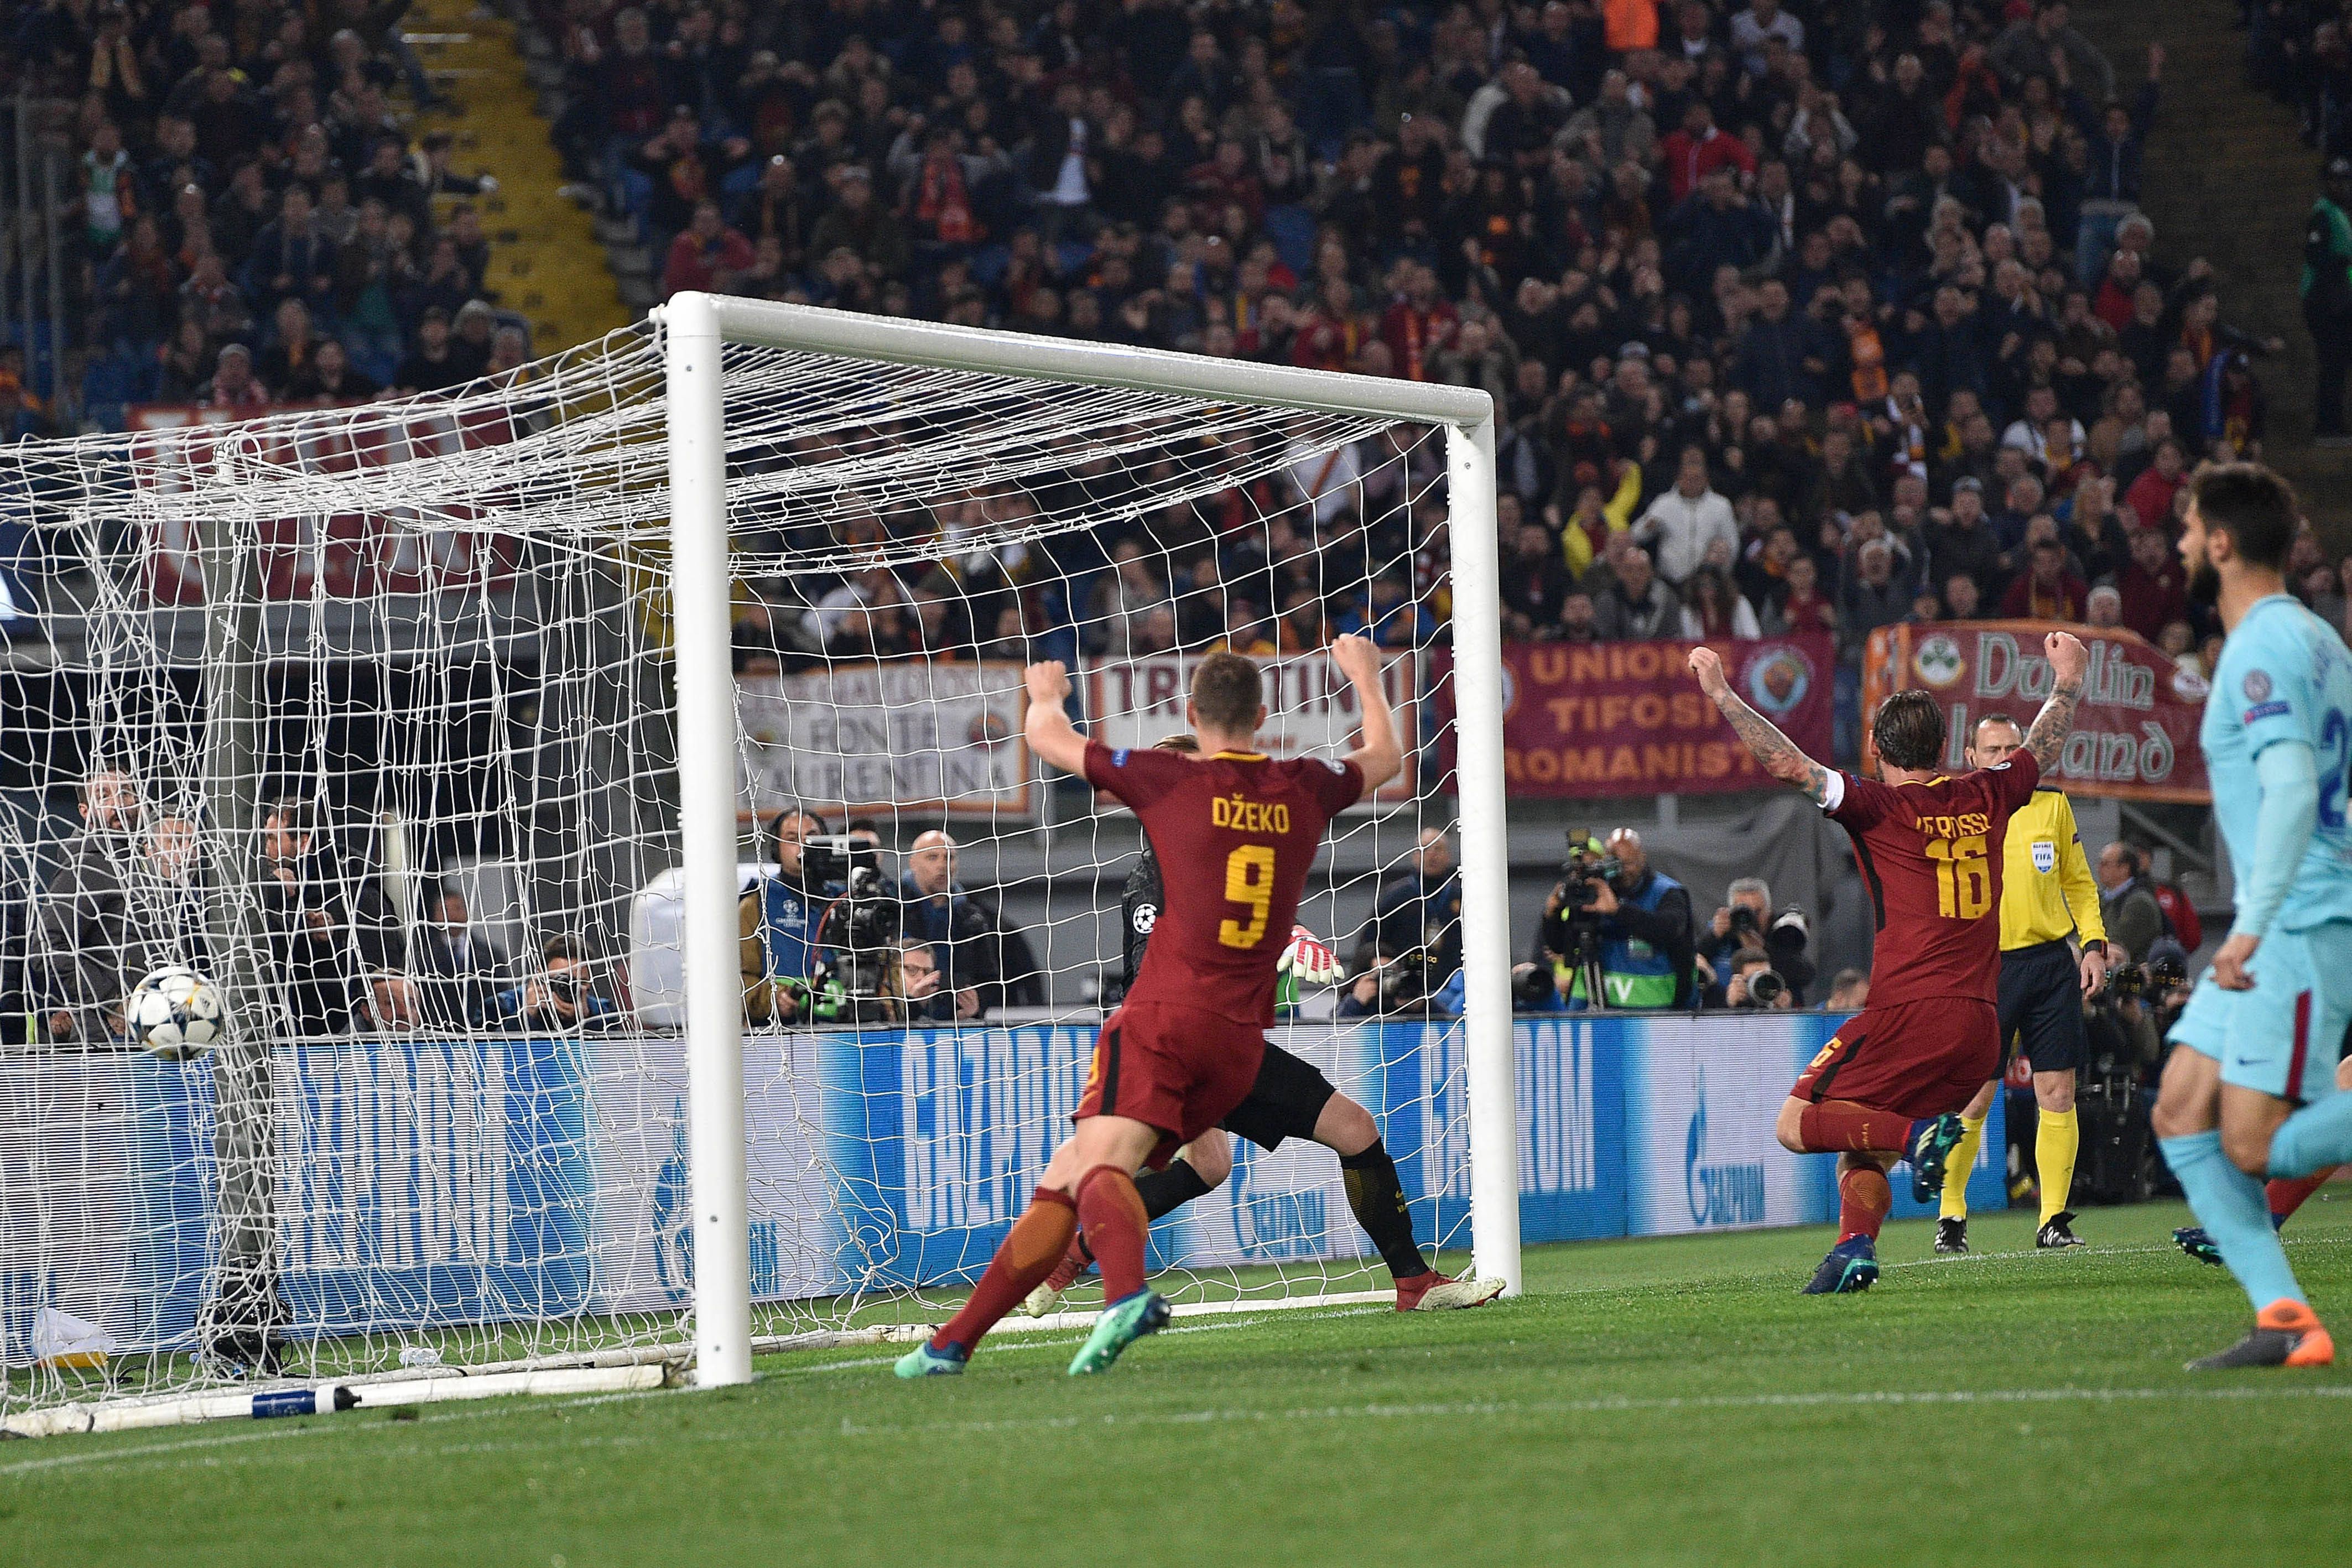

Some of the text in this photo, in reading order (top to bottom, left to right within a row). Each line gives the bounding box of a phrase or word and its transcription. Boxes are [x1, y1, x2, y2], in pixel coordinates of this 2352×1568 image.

[1548, 692, 1719, 734] TIFOSI
[1212, 792, 1289, 834] DŽEKO
[1217, 844, 1275, 950] 9
[1926, 835, 1991, 919] 16
[1605, 975, 1634, 1003] TV
[901, 1023, 1101, 1230] GAZPRO
